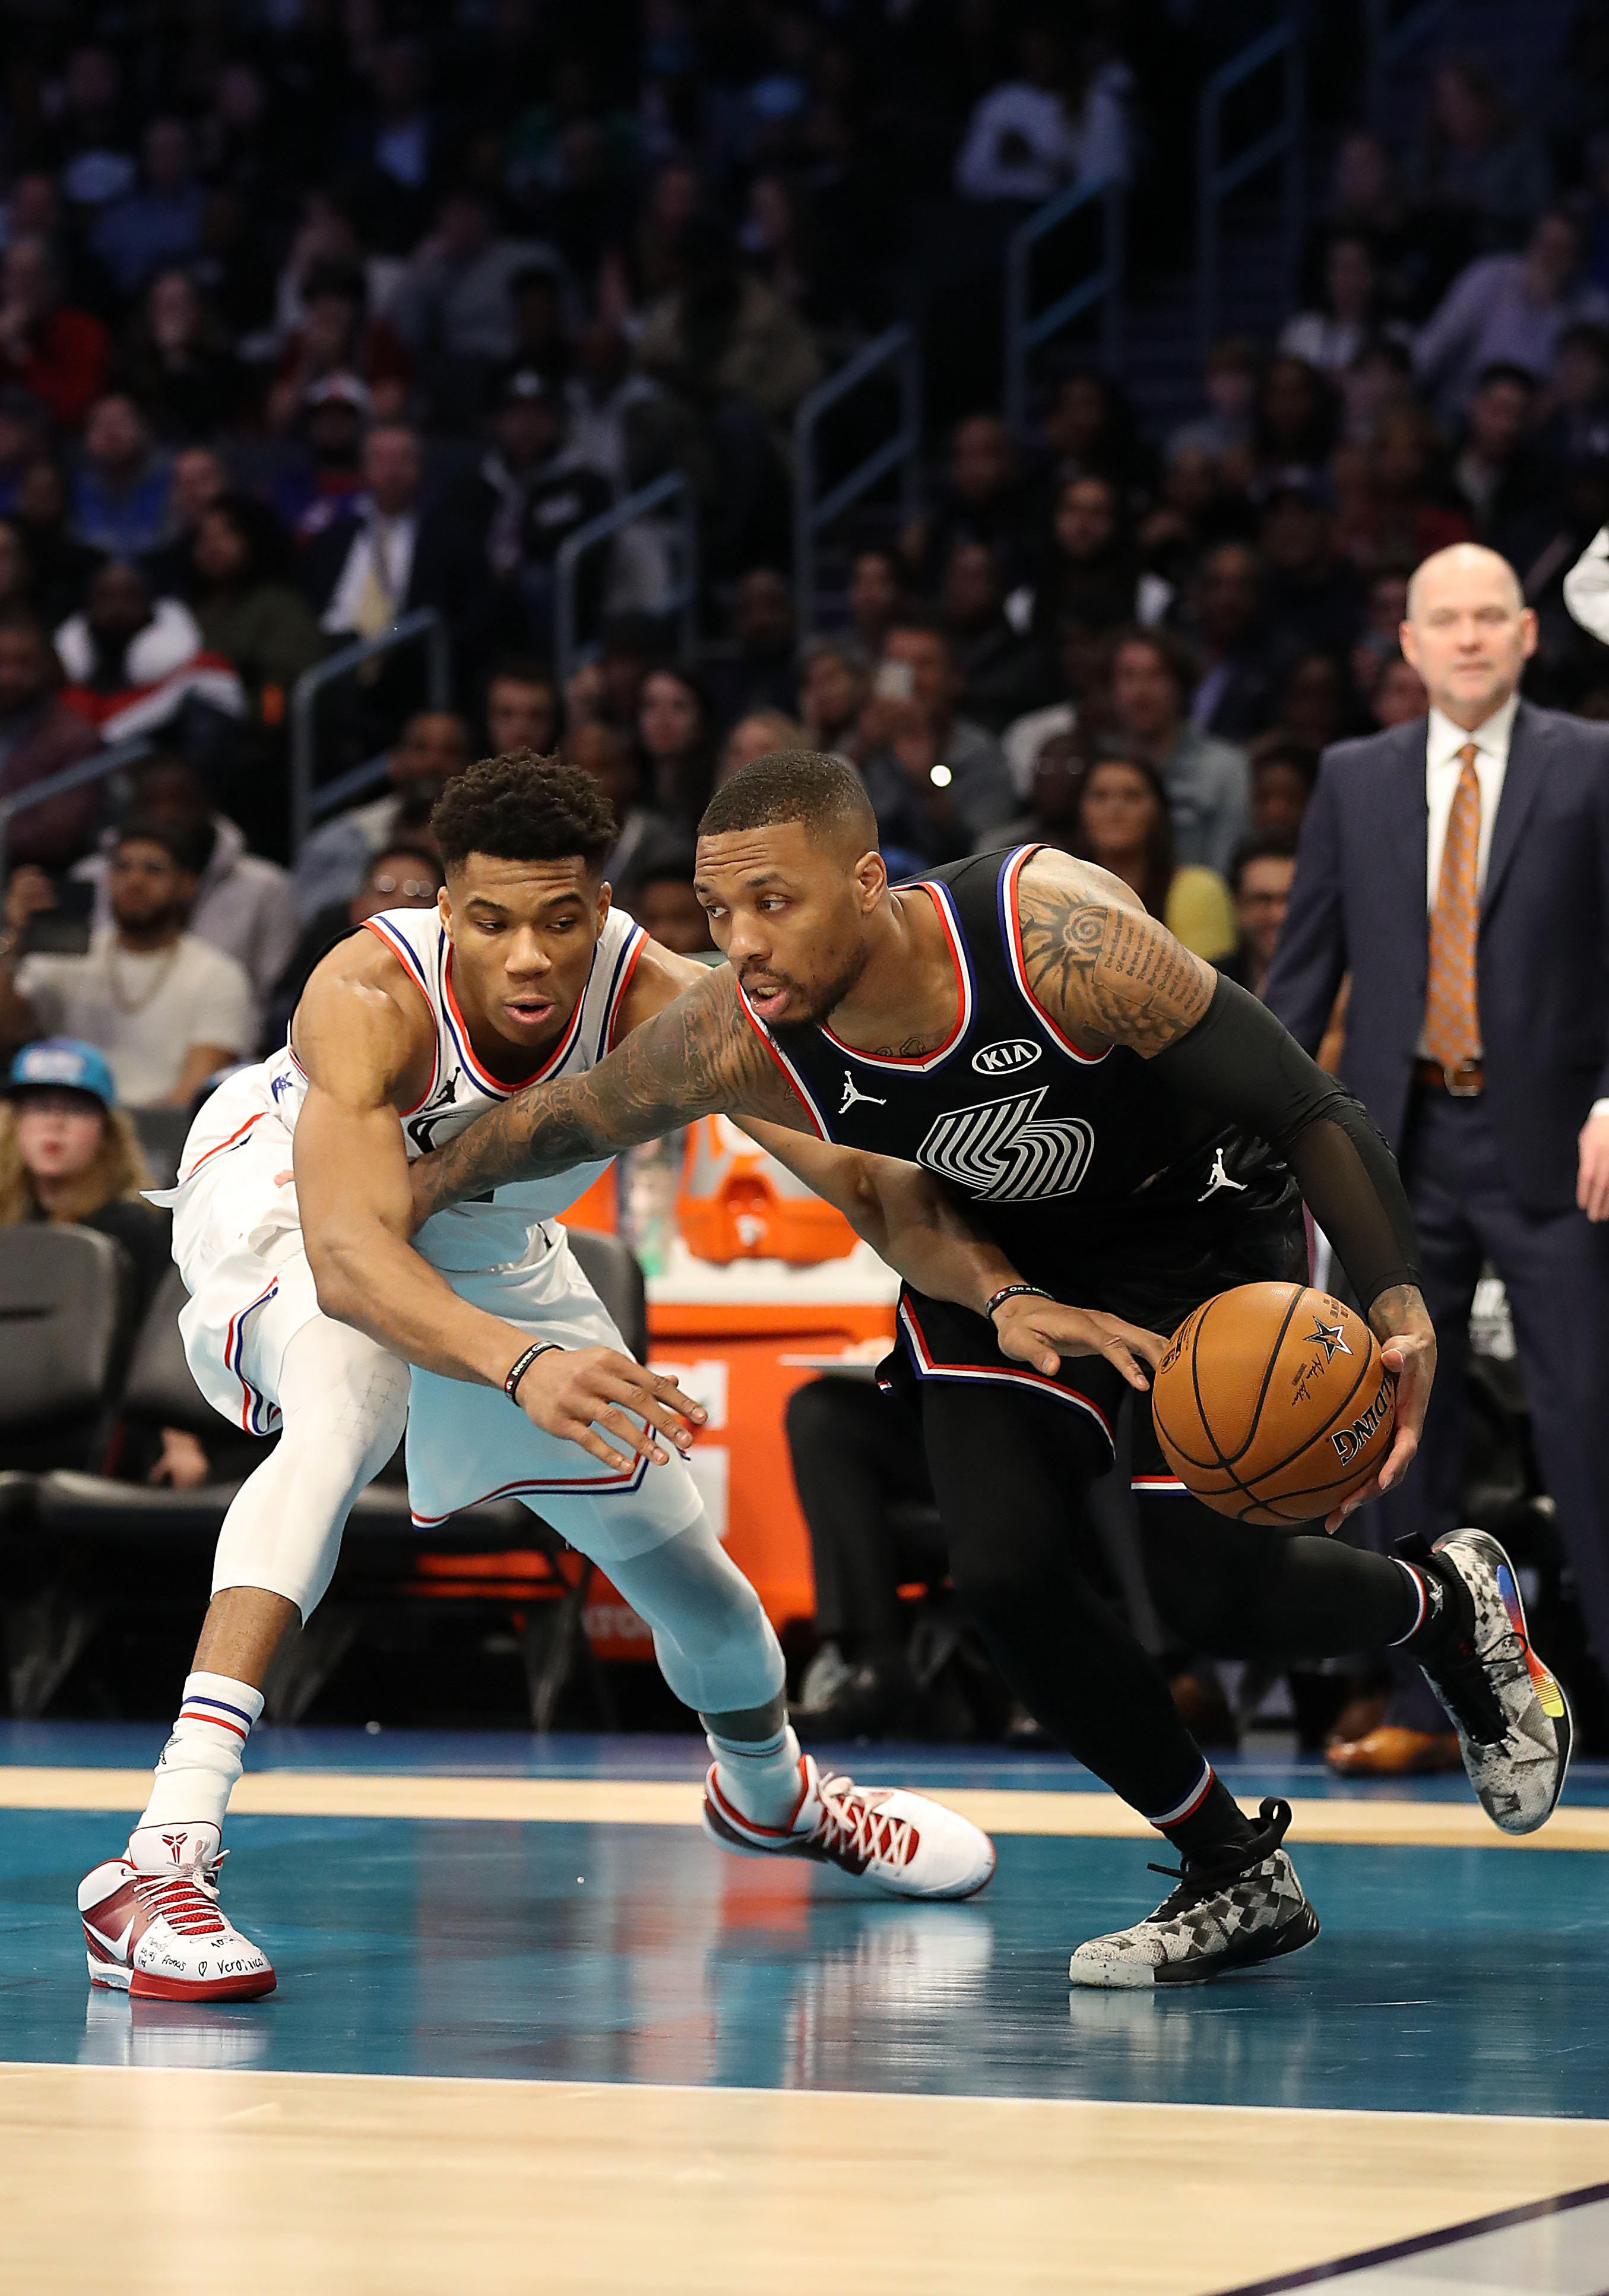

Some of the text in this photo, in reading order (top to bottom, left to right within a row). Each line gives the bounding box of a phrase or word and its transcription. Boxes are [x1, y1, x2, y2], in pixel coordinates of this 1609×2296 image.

[981, 1044, 1033, 1070] KIA
[512, 1351, 534, 1376] Never
[1331, 1377, 1393, 1466] LDING
